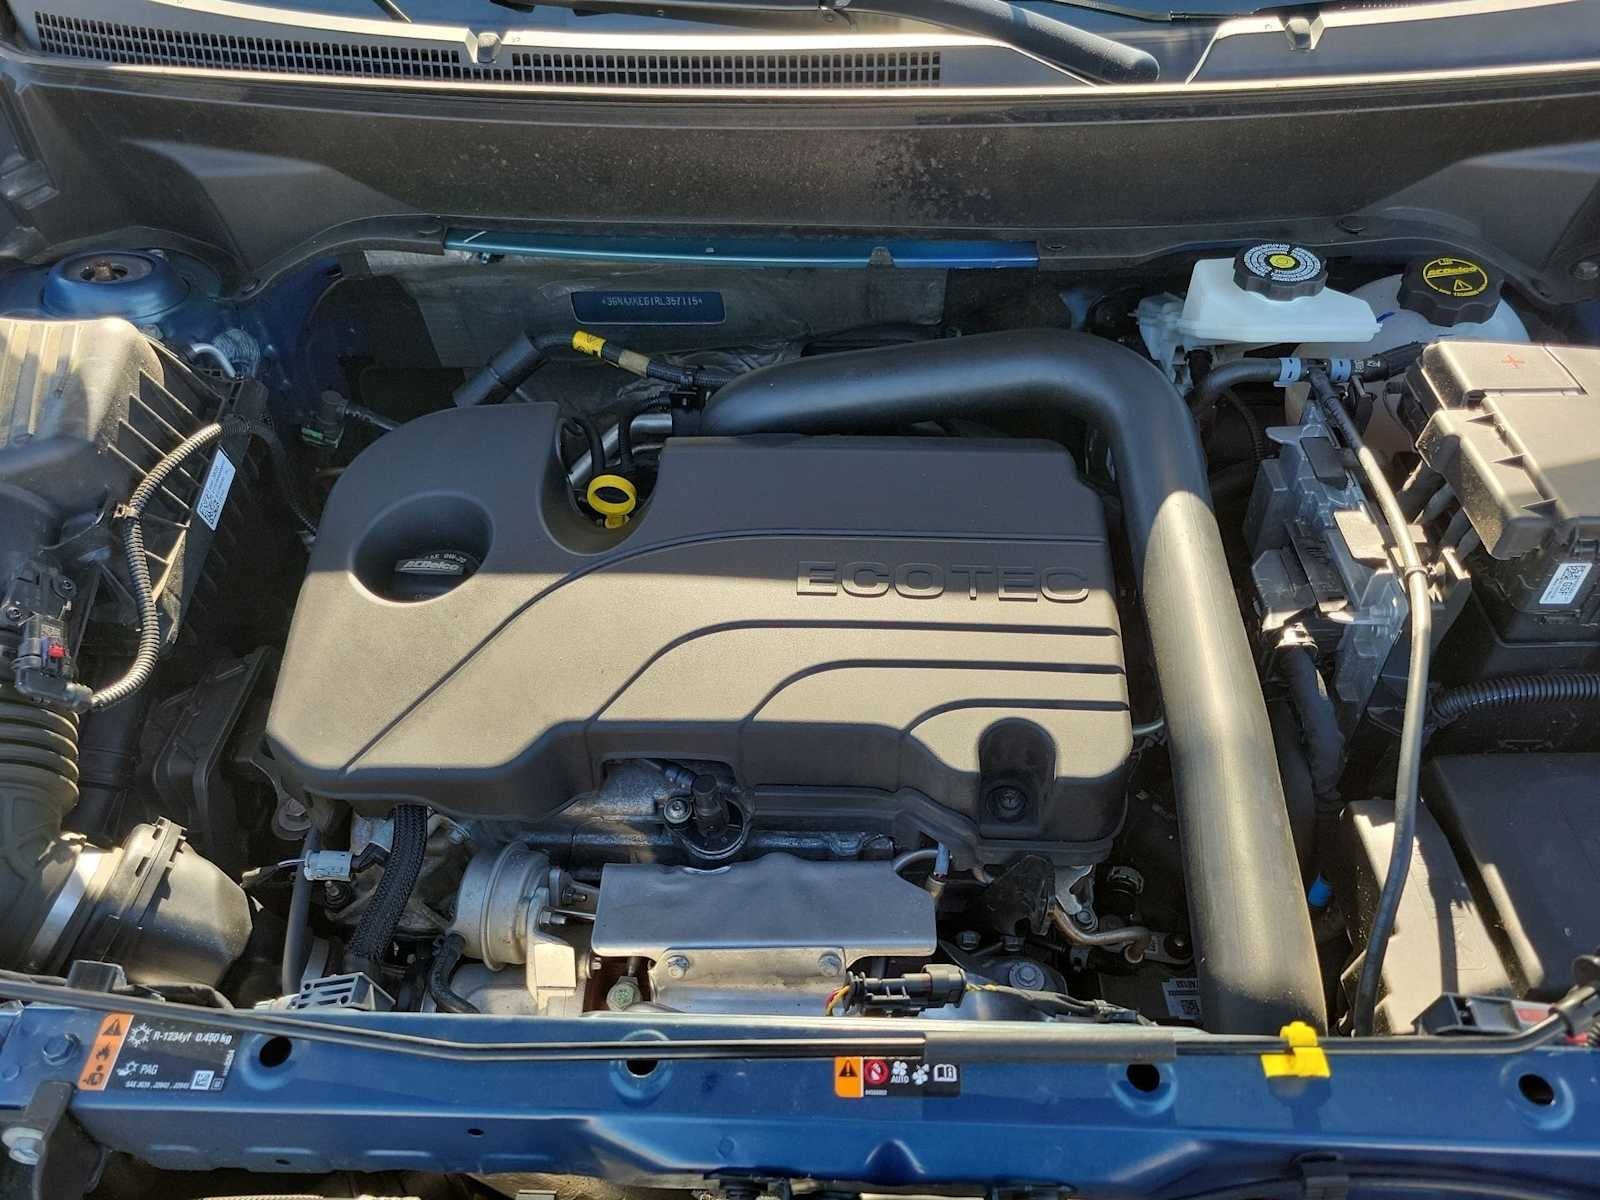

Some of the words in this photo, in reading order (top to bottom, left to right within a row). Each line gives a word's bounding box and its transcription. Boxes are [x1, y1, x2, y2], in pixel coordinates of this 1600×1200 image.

[796, 560, 1090, 604] ECOTEC
[139, 1064, 159, 1075] PAG
[890, 1075, 910, 1084] AUTO
